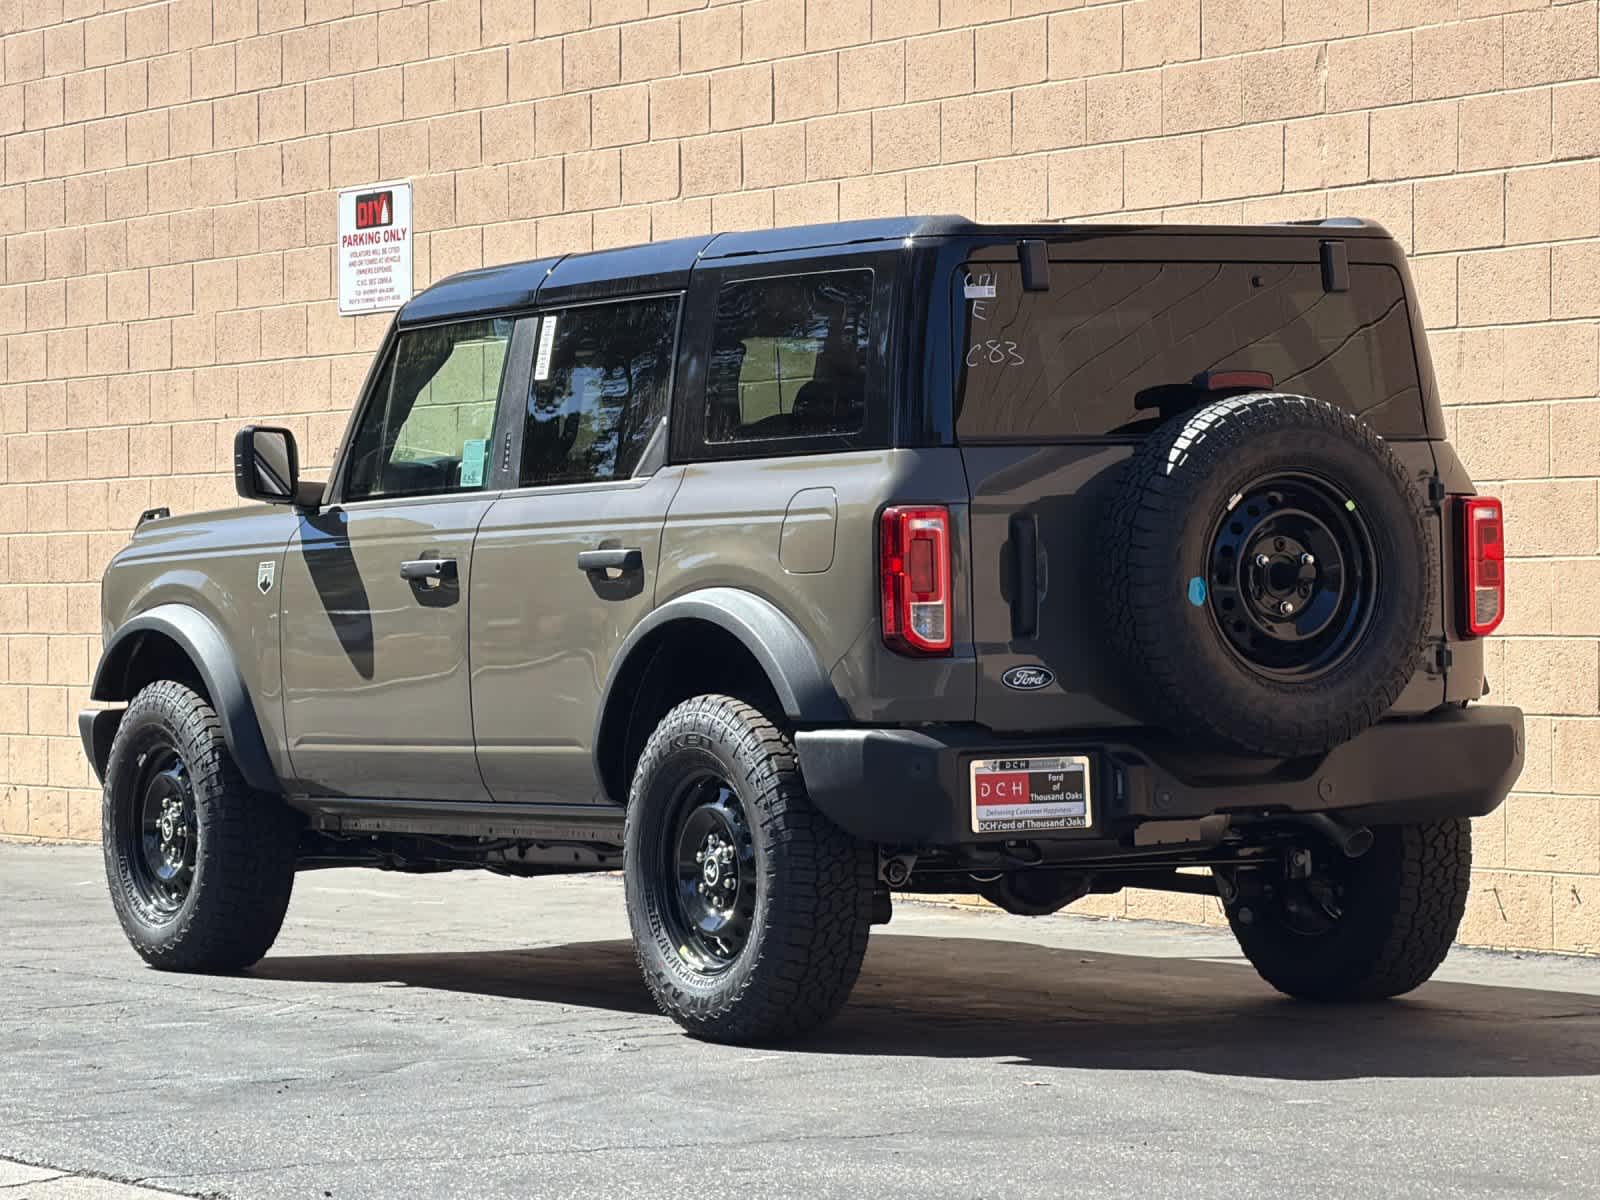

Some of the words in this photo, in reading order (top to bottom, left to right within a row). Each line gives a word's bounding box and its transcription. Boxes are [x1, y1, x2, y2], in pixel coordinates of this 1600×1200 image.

[358, 194, 386, 227] DIY
[342, 232, 380, 248] PARKING
[383, 228, 407, 243] ONLY
[1013, 670, 1044, 685] Ford
[1048, 773, 1064, 782] Ford
[981, 782, 1022, 797] DCH
[1052, 783, 1060, 791] of
[1030, 793, 1064, 801] Thousand
[1065, 791, 1082, 800] Oaks
[980, 823, 996, 831] DCH
[1016, 820, 1025, 829] of
[1026, 818, 1064, 828] Thousand
